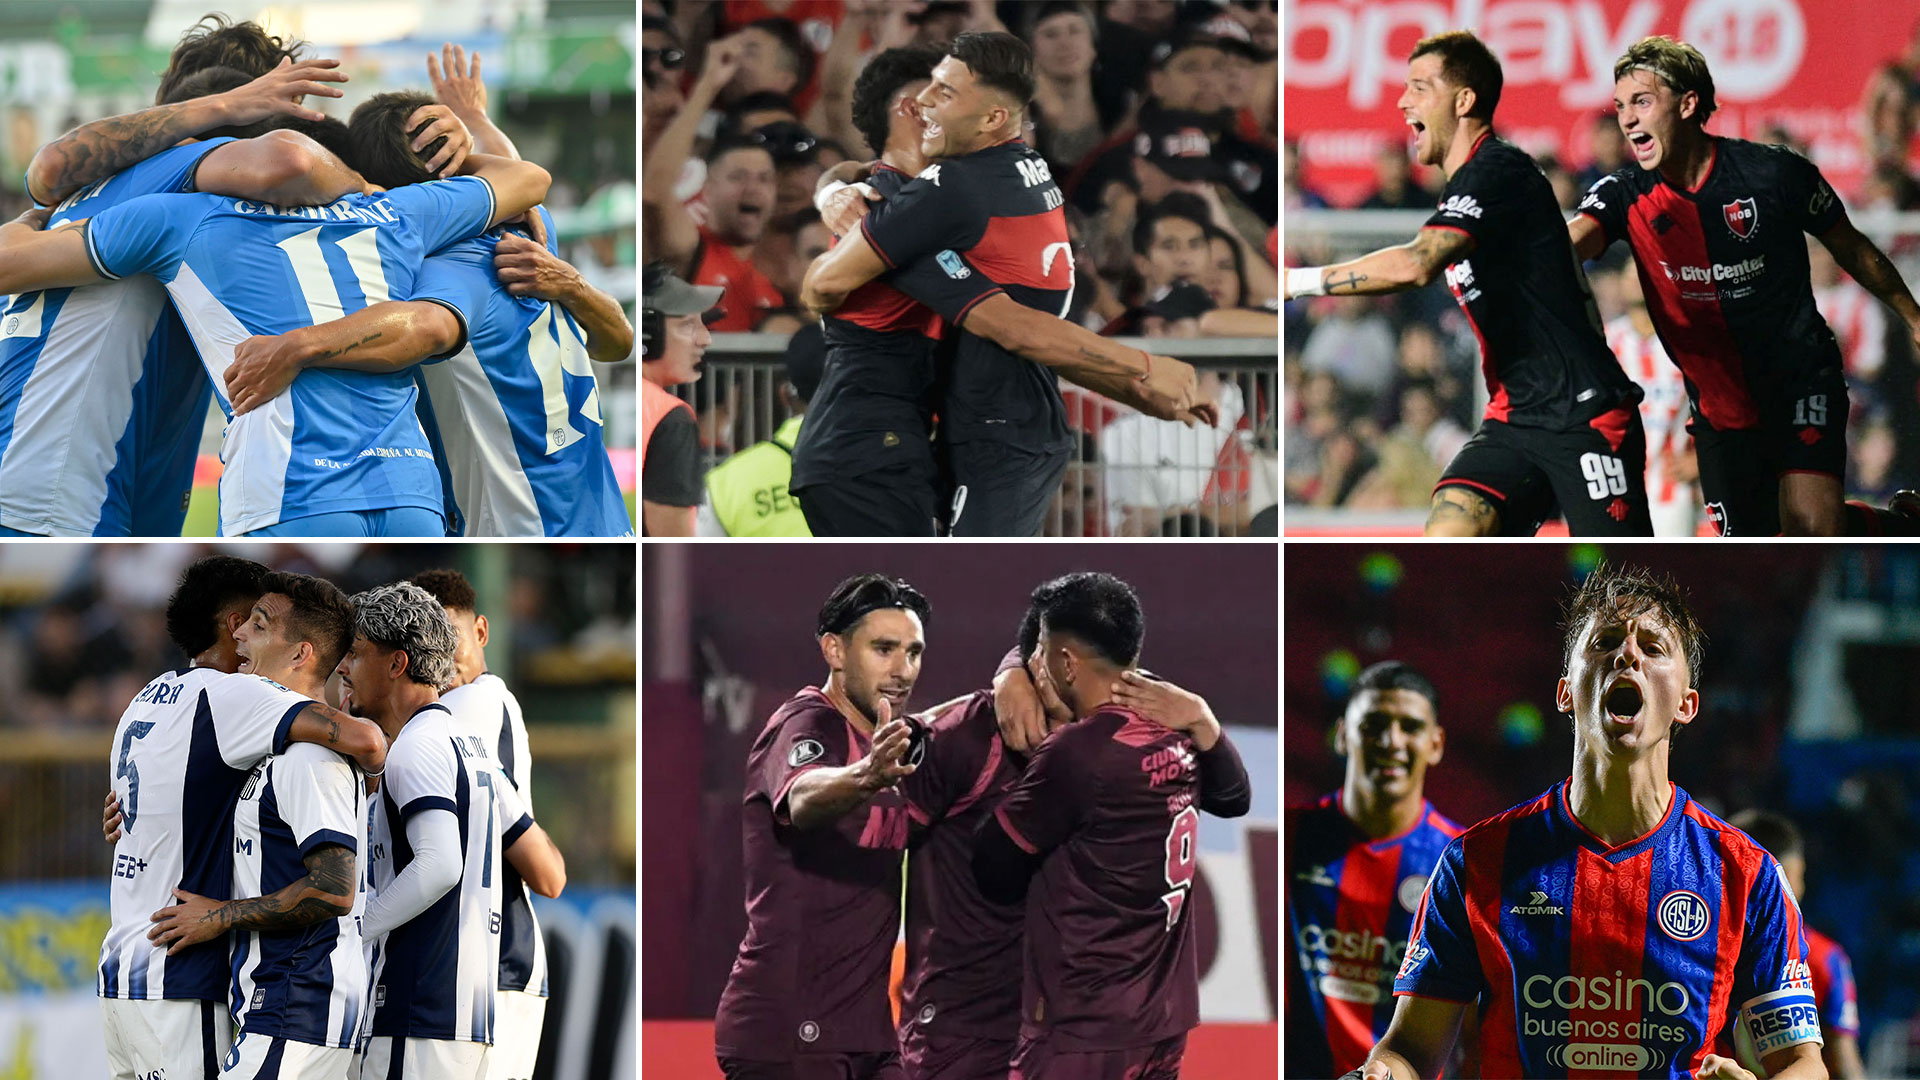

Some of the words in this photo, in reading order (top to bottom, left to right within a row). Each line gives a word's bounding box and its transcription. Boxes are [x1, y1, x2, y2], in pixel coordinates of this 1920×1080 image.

[1730, 208, 1752, 222] NOB
[276, 225, 392, 326] 11
[1680, 265, 1712, 285] City
[1712, 254, 1765, 281] Center
[116, 720, 156, 835] 5
[1161, 805, 1200, 933] 9
[1510, 905, 1564, 916] ATOMIK
[1523, 969, 1690, 1017] casino
[1524, 1012, 1620, 1039] buenos
[1624, 1017, 1686, 1043] aires
[1768, 1027, 1818, 1048] TITULAR
[1571, 1046, 1638, 1067] online
